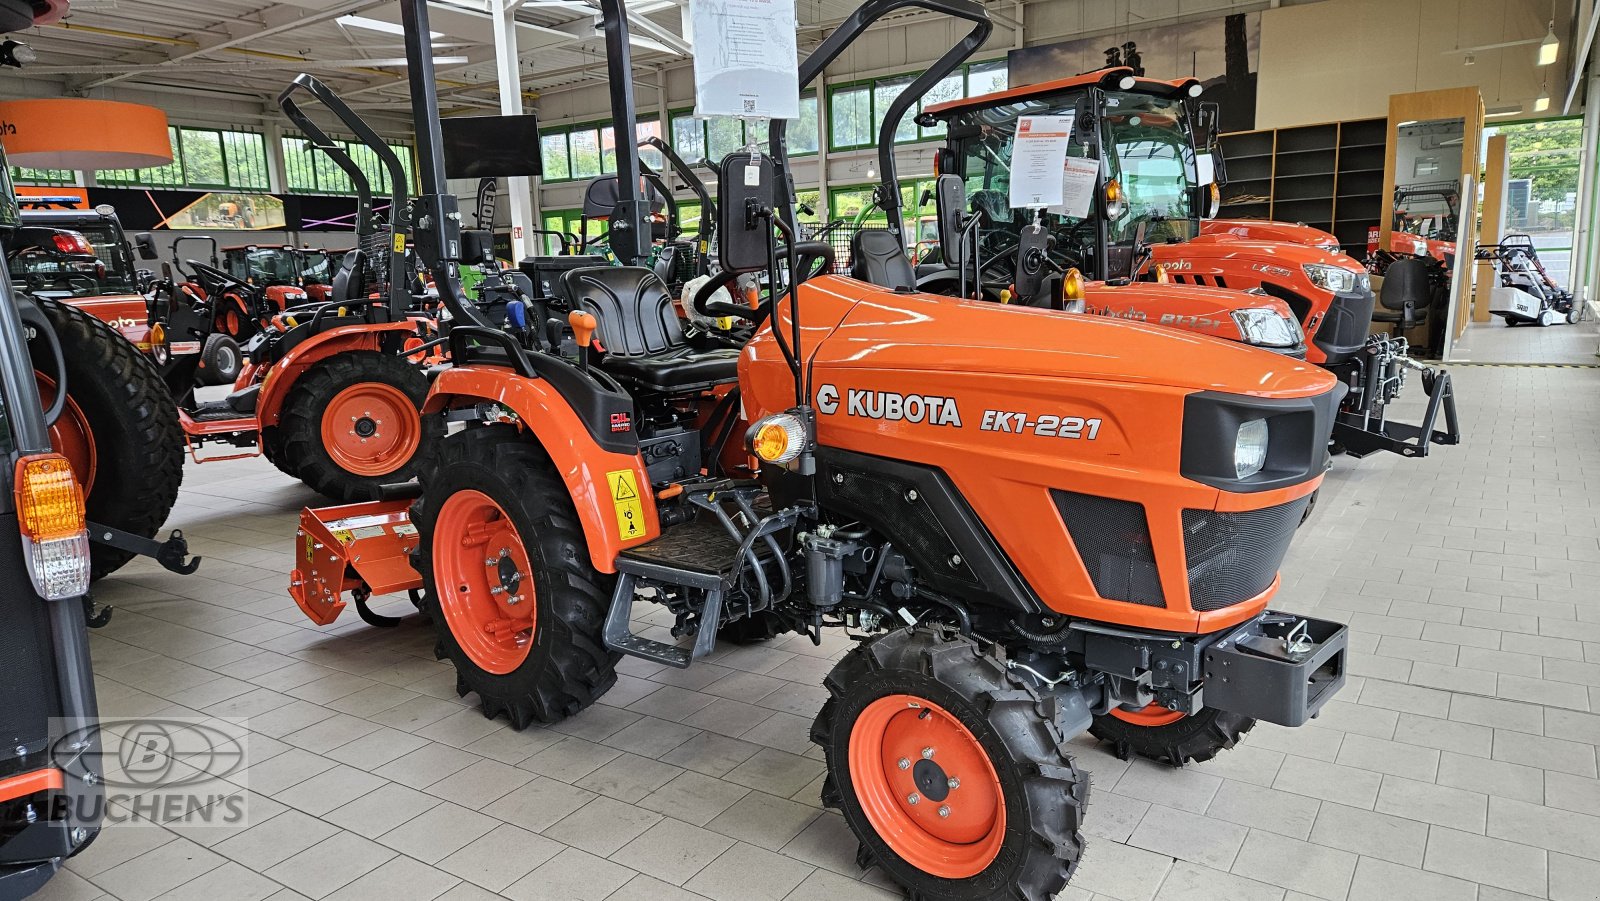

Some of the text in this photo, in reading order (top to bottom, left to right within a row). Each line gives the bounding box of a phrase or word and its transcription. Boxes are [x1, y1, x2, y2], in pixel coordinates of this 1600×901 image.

[1159, 312, 1222, 330] B1-121
[847, 388, 1103, 440] KUBOTA EK1-221
